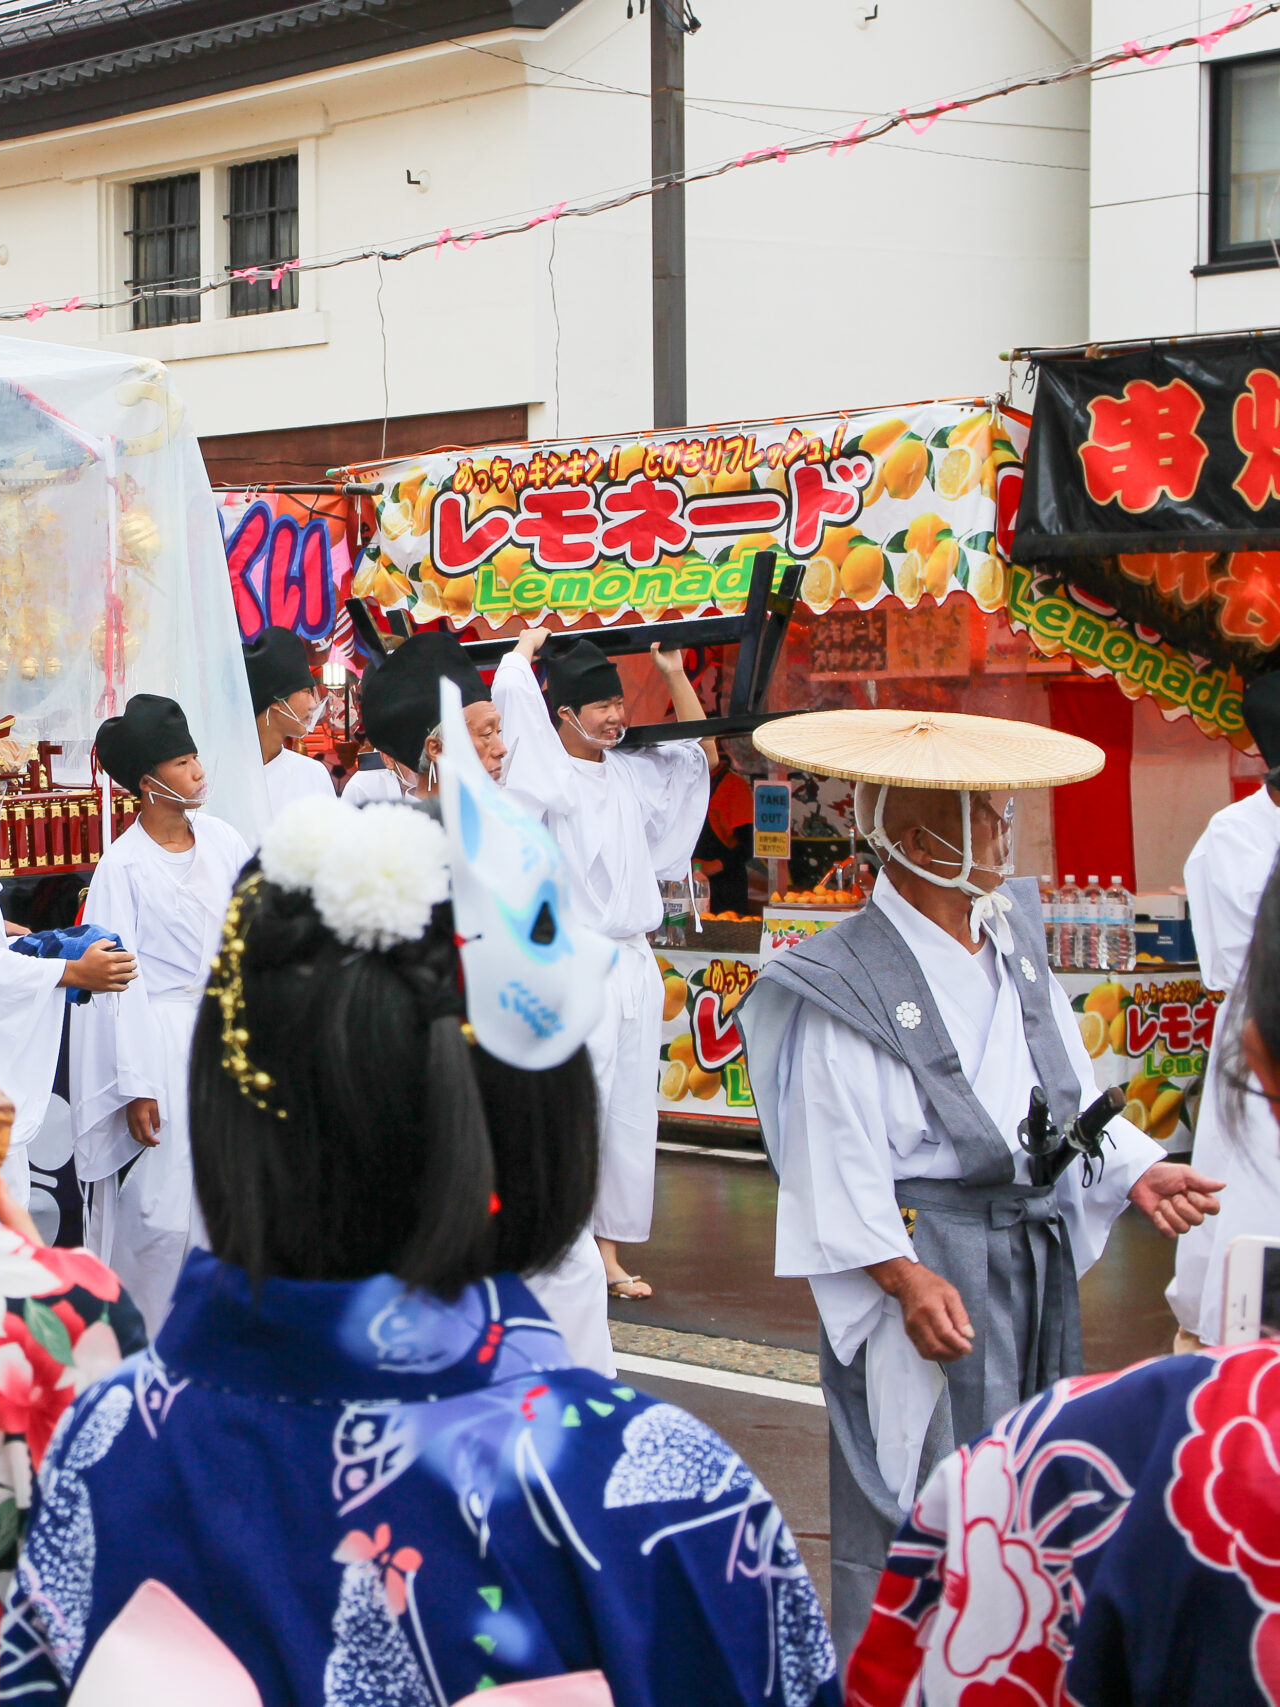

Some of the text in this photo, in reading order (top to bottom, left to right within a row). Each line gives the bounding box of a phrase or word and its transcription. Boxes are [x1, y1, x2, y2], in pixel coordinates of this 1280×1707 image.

[452, 423, 849, 493] めっちゃキンキン！ とびきりフレッシュ！
[435, 455, 872, 574] レモネード
[1006, 564, 1245, 733] Lemonade
[759, 794, 786, 806] TAKE
[761, 812, 782, 824] OUT
[772, 932, 812, 949] レモ
